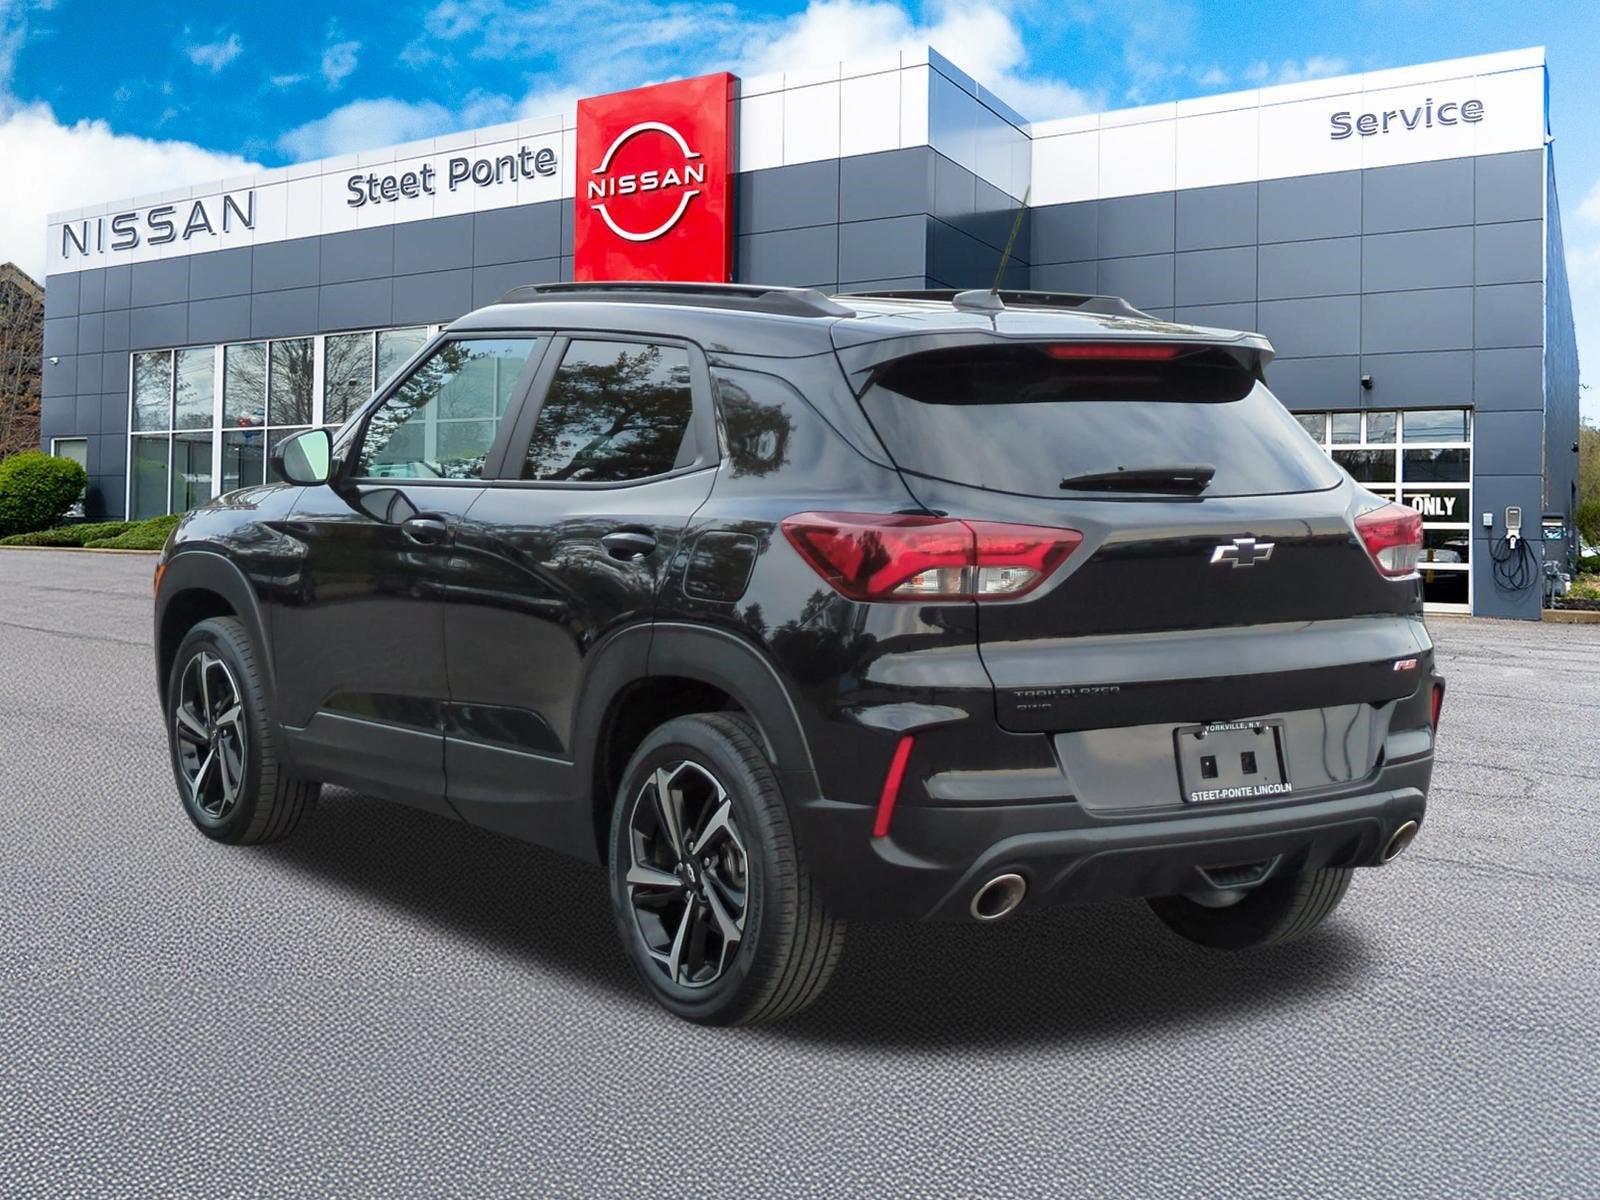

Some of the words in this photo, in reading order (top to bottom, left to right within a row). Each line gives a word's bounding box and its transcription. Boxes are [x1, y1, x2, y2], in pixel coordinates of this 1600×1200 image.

[1330, 98, 1484, 140] Service
[347, 163, 436, 207] Steet
[449, 145, 558, 192] Ponte
[588, 163, 705, 199] NISSAN
[62, 190, 256, 259] NISSAN
[1411, 497, 1456, 516] ONLY
[1191, 786, 1253, 801] STEET-PONTE
[1254, 782, 1292, 795] LINCOLN
